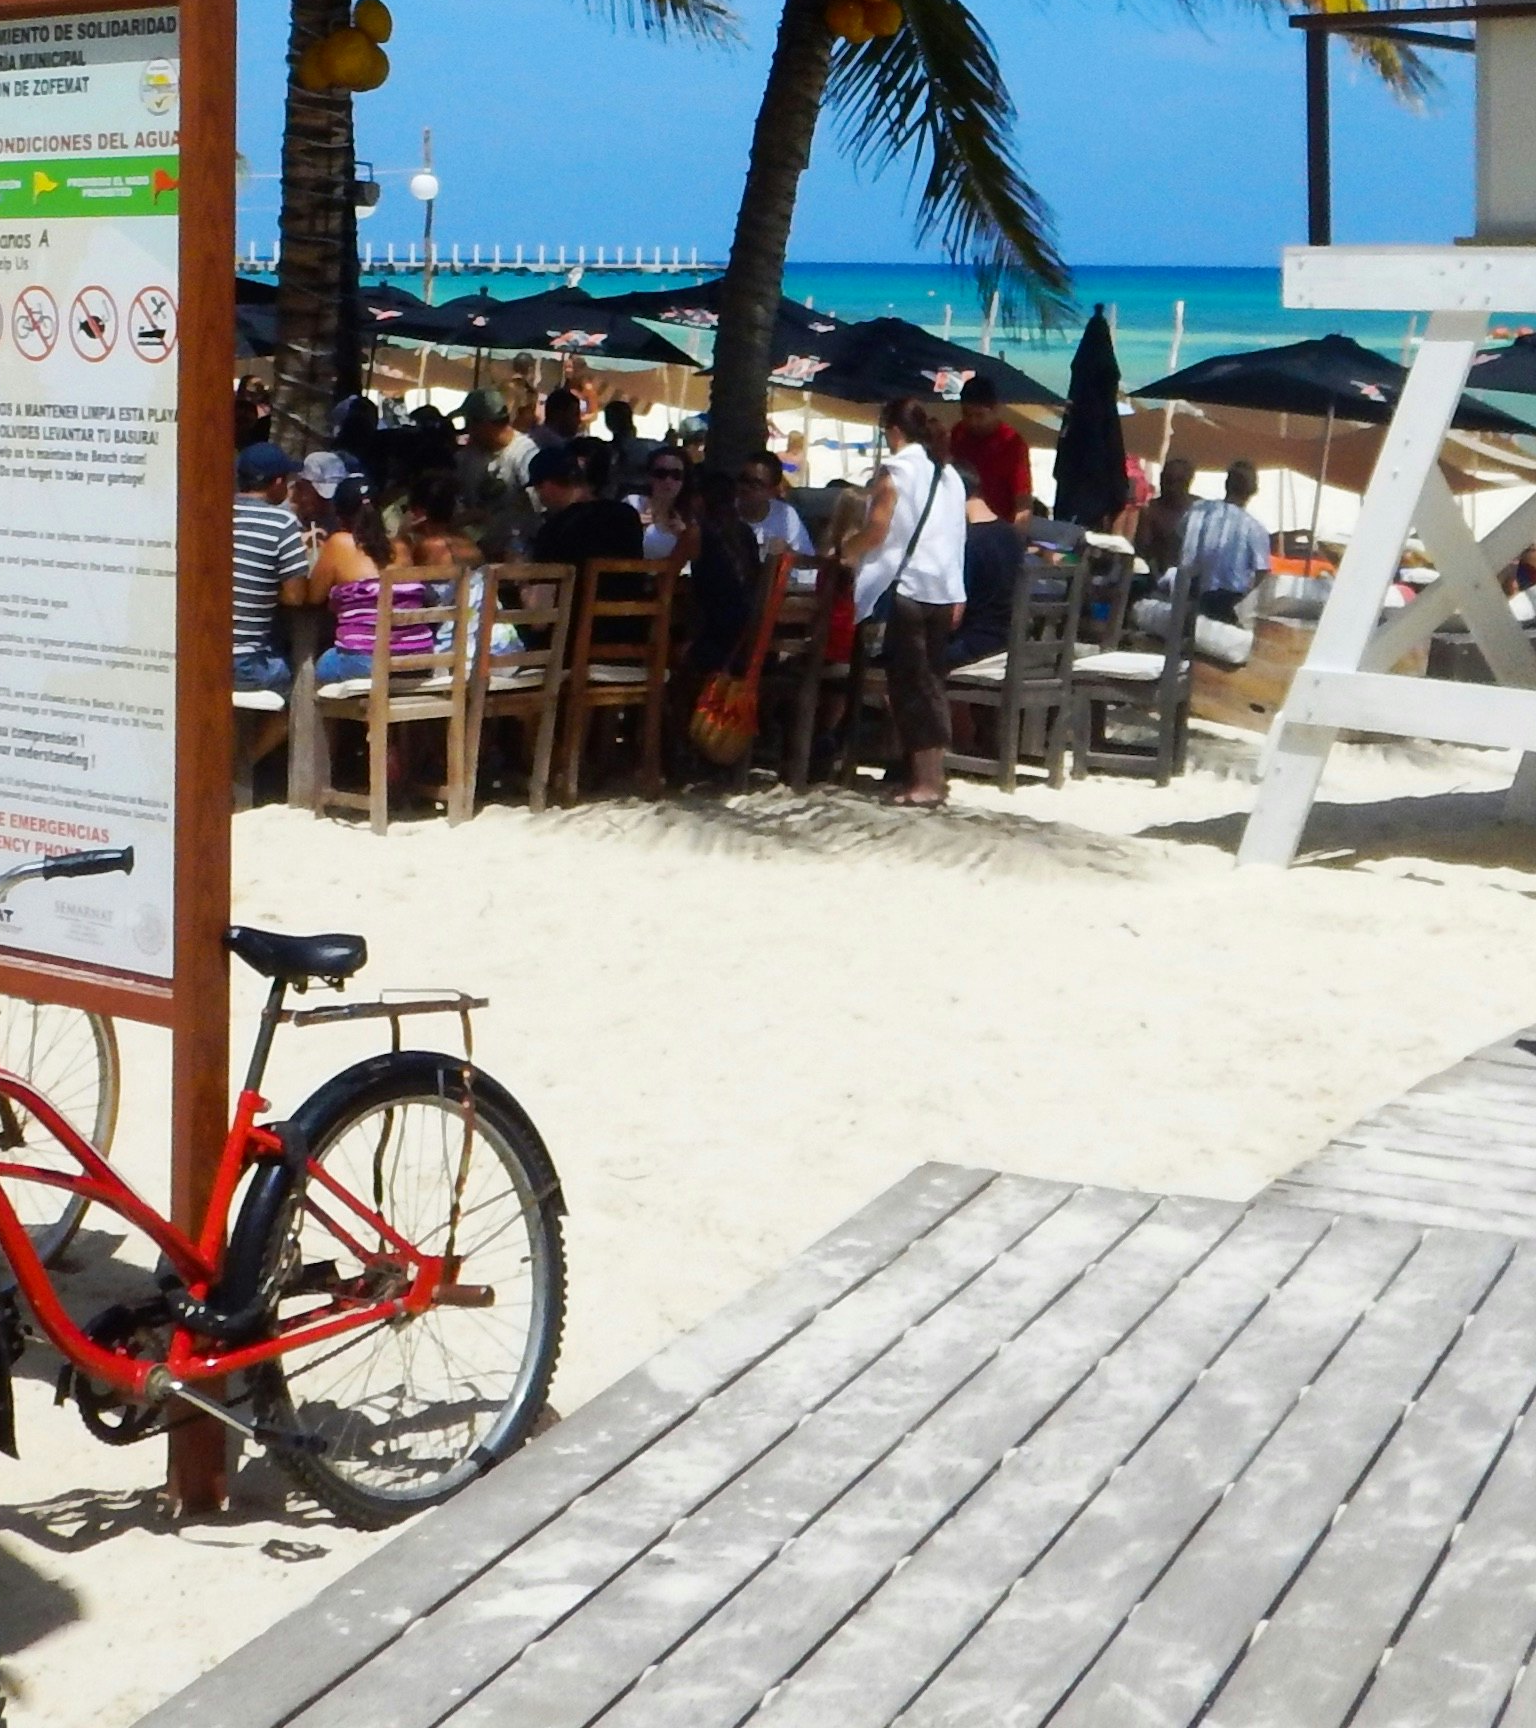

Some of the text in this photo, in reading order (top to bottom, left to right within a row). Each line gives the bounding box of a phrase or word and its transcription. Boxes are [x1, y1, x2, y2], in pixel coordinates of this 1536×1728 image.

[54, 24, 73, 41] DE
[77, 16, 176, 40] SOLIDARIDAD
[20, 50, 86, 70] MUNICIPAL
[14, 80, 29, 97] DE
[33, 76, 90, 96] ZOFEMAT
[98, 132, 128, 150] DEL
[135, 130, 180, 149] AGUA
[39, 229, 50, 247] A
[16, 256, 29, 270] Us
[16, 403, 22, 416] A
[25, 404, 78, 419] MANTENER
[82, 405, 116, 420] LIMPIA
[119, 407, 145, 421] ESTA
[0, 424, 40, 439] OLVIDES
[43, 426, 94, 441] LEVANTAR
[98, 428, 111, 443] TU
[115, 429, 159, 445] BASURA!
[14, 746, 89, 771] understanding
[10, 814, 110, 844] EMERGENCIAS
